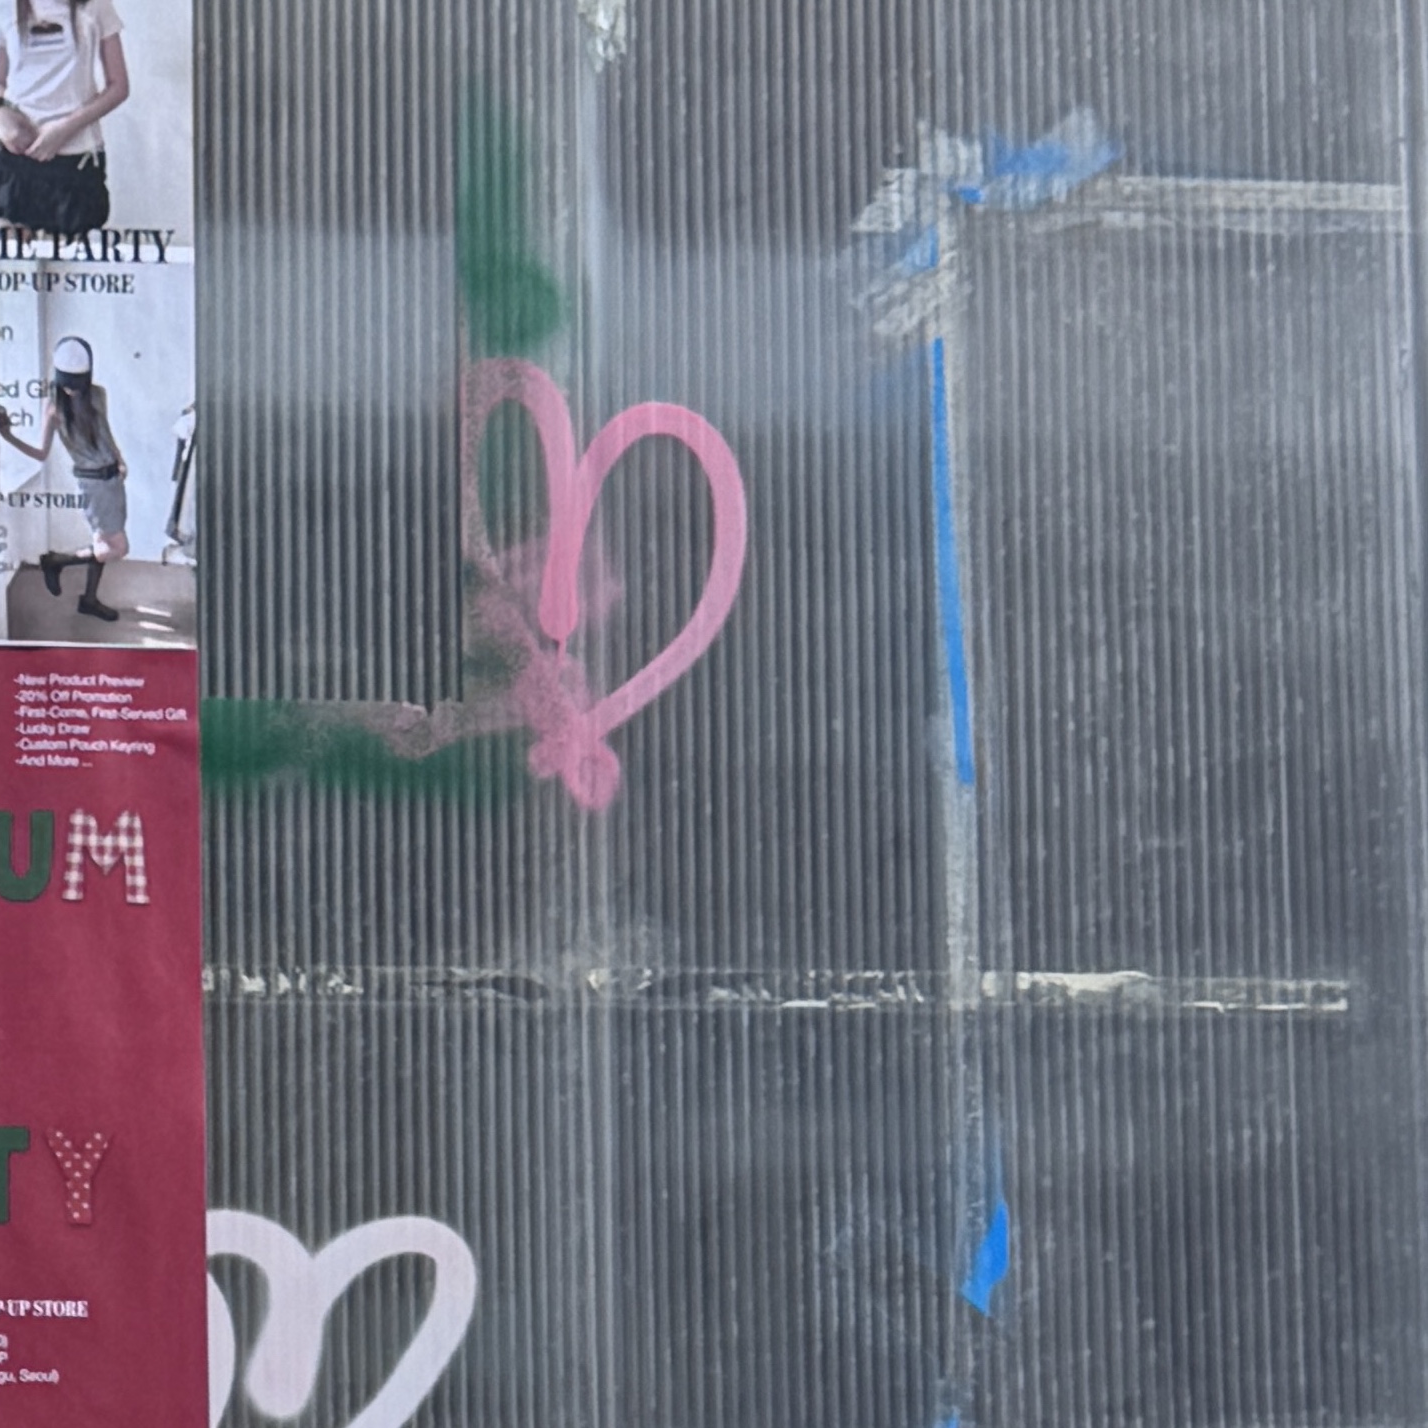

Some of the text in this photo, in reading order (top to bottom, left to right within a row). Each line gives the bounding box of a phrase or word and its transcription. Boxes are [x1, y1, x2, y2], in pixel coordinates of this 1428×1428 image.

[53, 229, 174, 263] PARTY
[65, 274, 135, 294] STORE
[47, 755, 79, 767] More
[33, 1300, 88, 1318] STORE
